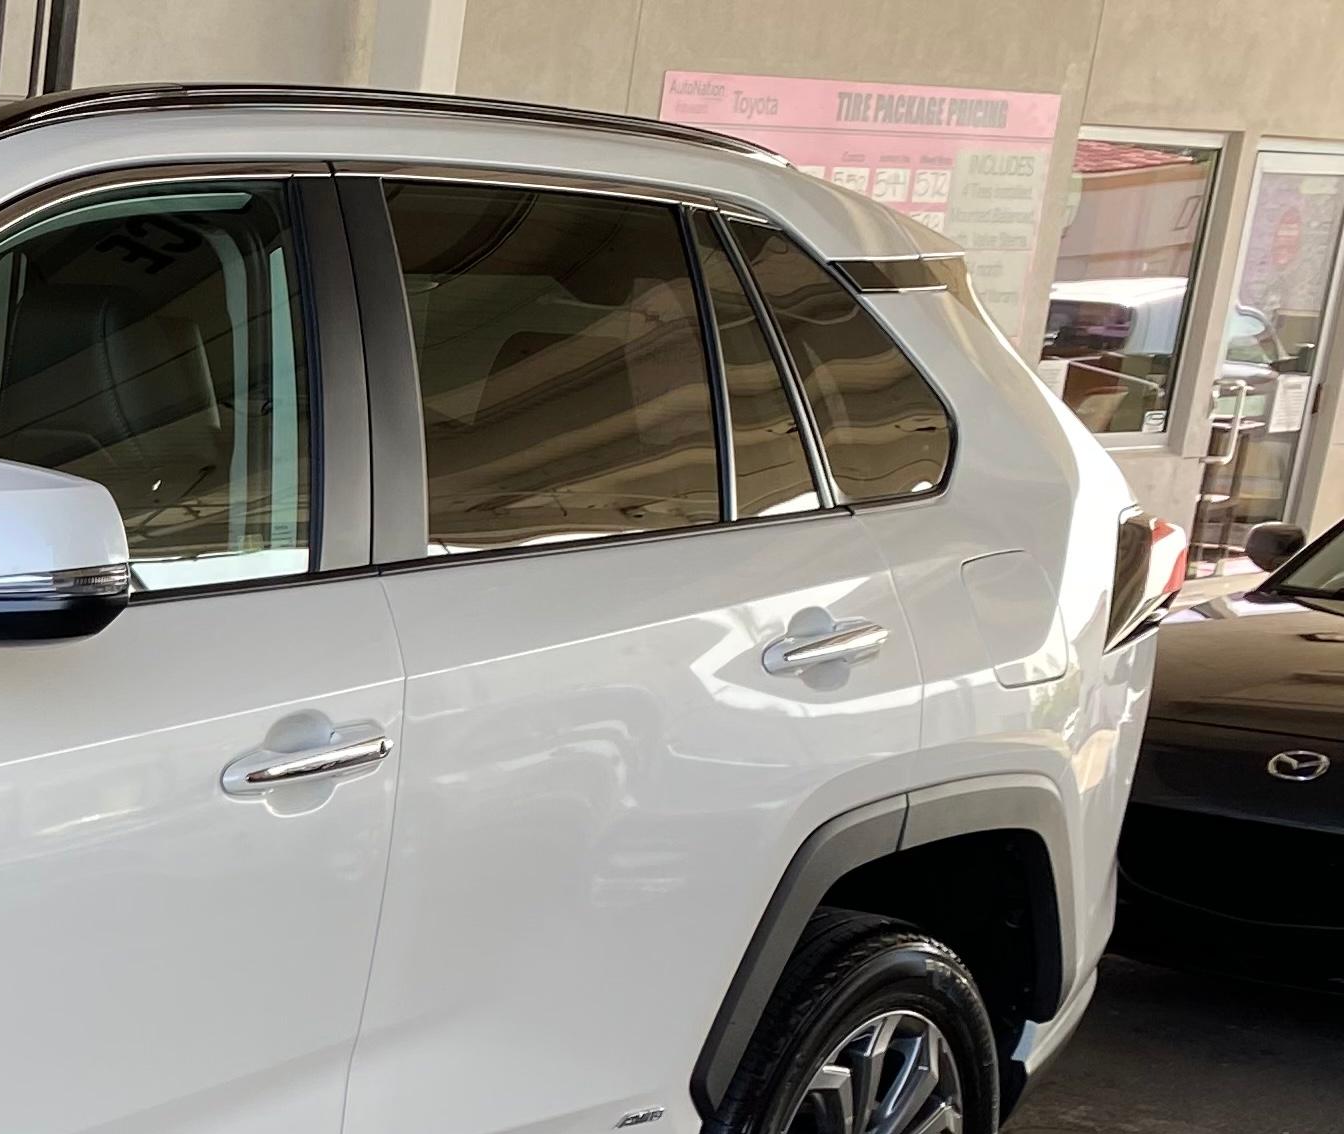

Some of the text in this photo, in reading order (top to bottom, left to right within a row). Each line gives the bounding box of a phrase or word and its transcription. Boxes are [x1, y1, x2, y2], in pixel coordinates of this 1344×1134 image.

[669, 79, 725, 97] AutoNation
[732, 90, 779, 119] Toyota
[835, 91, 1009, 129] TIRE PACKAGE PRICING
[968, 153, 1036, 177] INCLUDES
